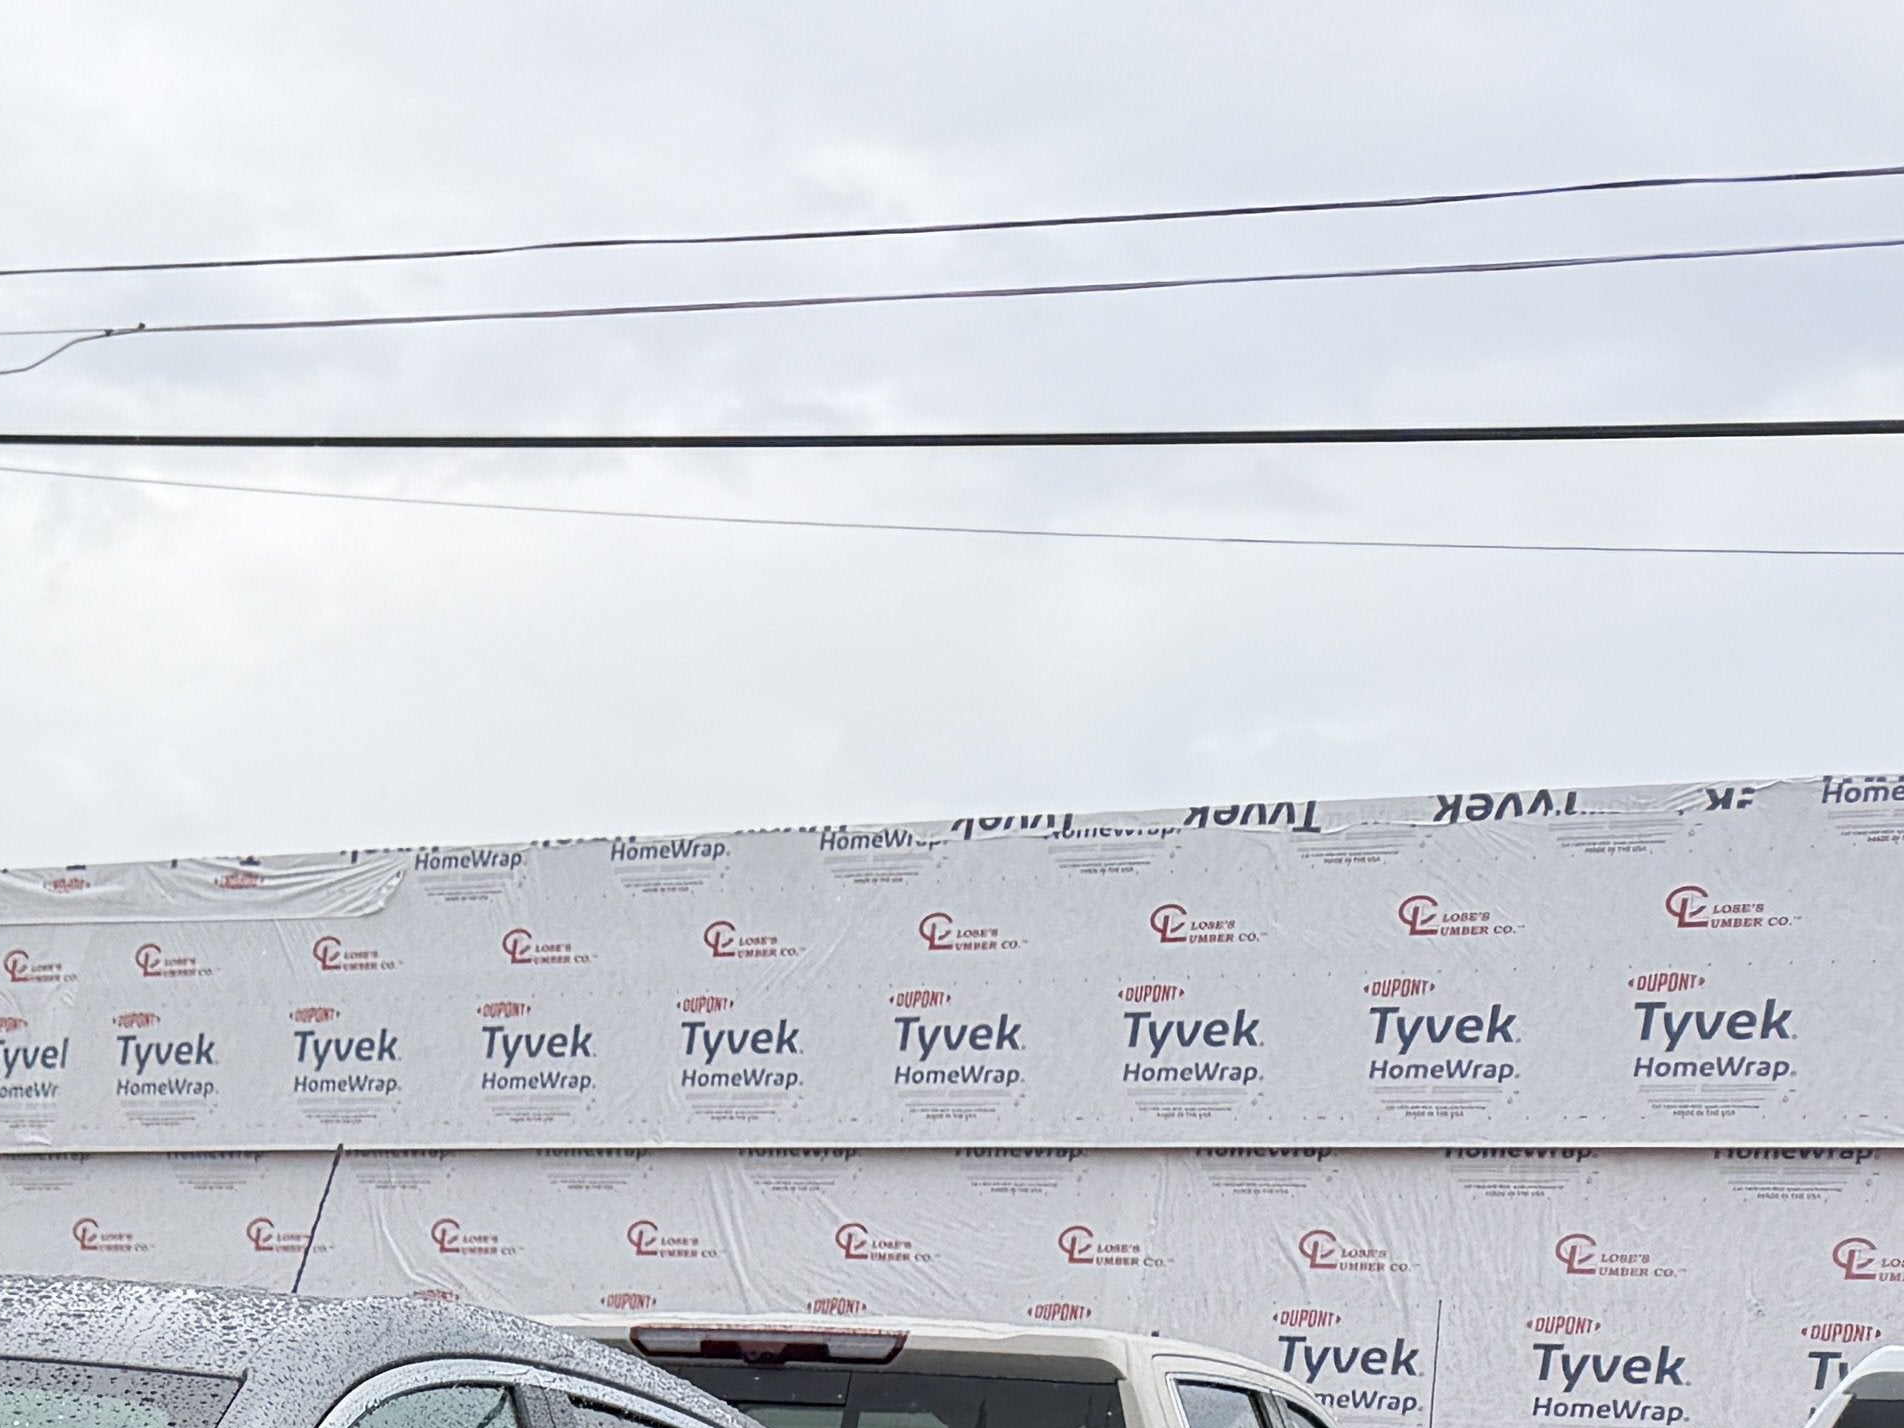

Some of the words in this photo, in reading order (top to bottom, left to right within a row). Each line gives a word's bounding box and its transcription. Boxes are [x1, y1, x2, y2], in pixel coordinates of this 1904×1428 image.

[414, 850, 522, 871] HomeWrap
[610, 838, 726, 861] HomeWrap
[1125, 984, 1178, 1004] DUPONT
[1371, 978, 1429, 998] DUPONT
[1636, 972, 1698, 992] DUPONT
[896, 990, 944, 1008] DUPONT
[894, 1013, 1020, 1062] Tyvek
[1123, 1008, 1259, 1060] Tyvek
[1369, 1003, 1516, 1056] Tyvek
[1634, 998, 1791, 1053] Tyvek
[294, 1028, 397, 1072] Tyvek
[482, 1023, 591, 1069] Tyvek
[681, 1019, 798, 1065] Tyvek
[117, 1033, 214, 1076] Tyvek
[681, 1067, 799, 1090] HomeWrap
[894, 1064, 1020, 1088] HomeWrap
[1123, 1061, 1259, 1086] HomeWrap
[1369, 1058, 1515, 1084] HomeWrap
[1634, 1055, 1792, 1082] HomeWrap
[117, 1078, 215, 1098] HomeWrap
[294, 1075, 398, 1096] HomeWrap
[482, 1071, 592, 1093] HomeWrap
[1034, 1303, 1085, 1322] DUPONT
[1280, 1309, 1334, 1328] DUPONT
[1535, 1315, 1593, 1335] DUPONT
[1810, 1323, 1872, 1343] DUPONT
[1278, 1335, 1416, 1384] Tyvek
[1533, 1343, 1686, 1393] Tyvek
[1532, 1396, 1686, 1427] HomeWrap
